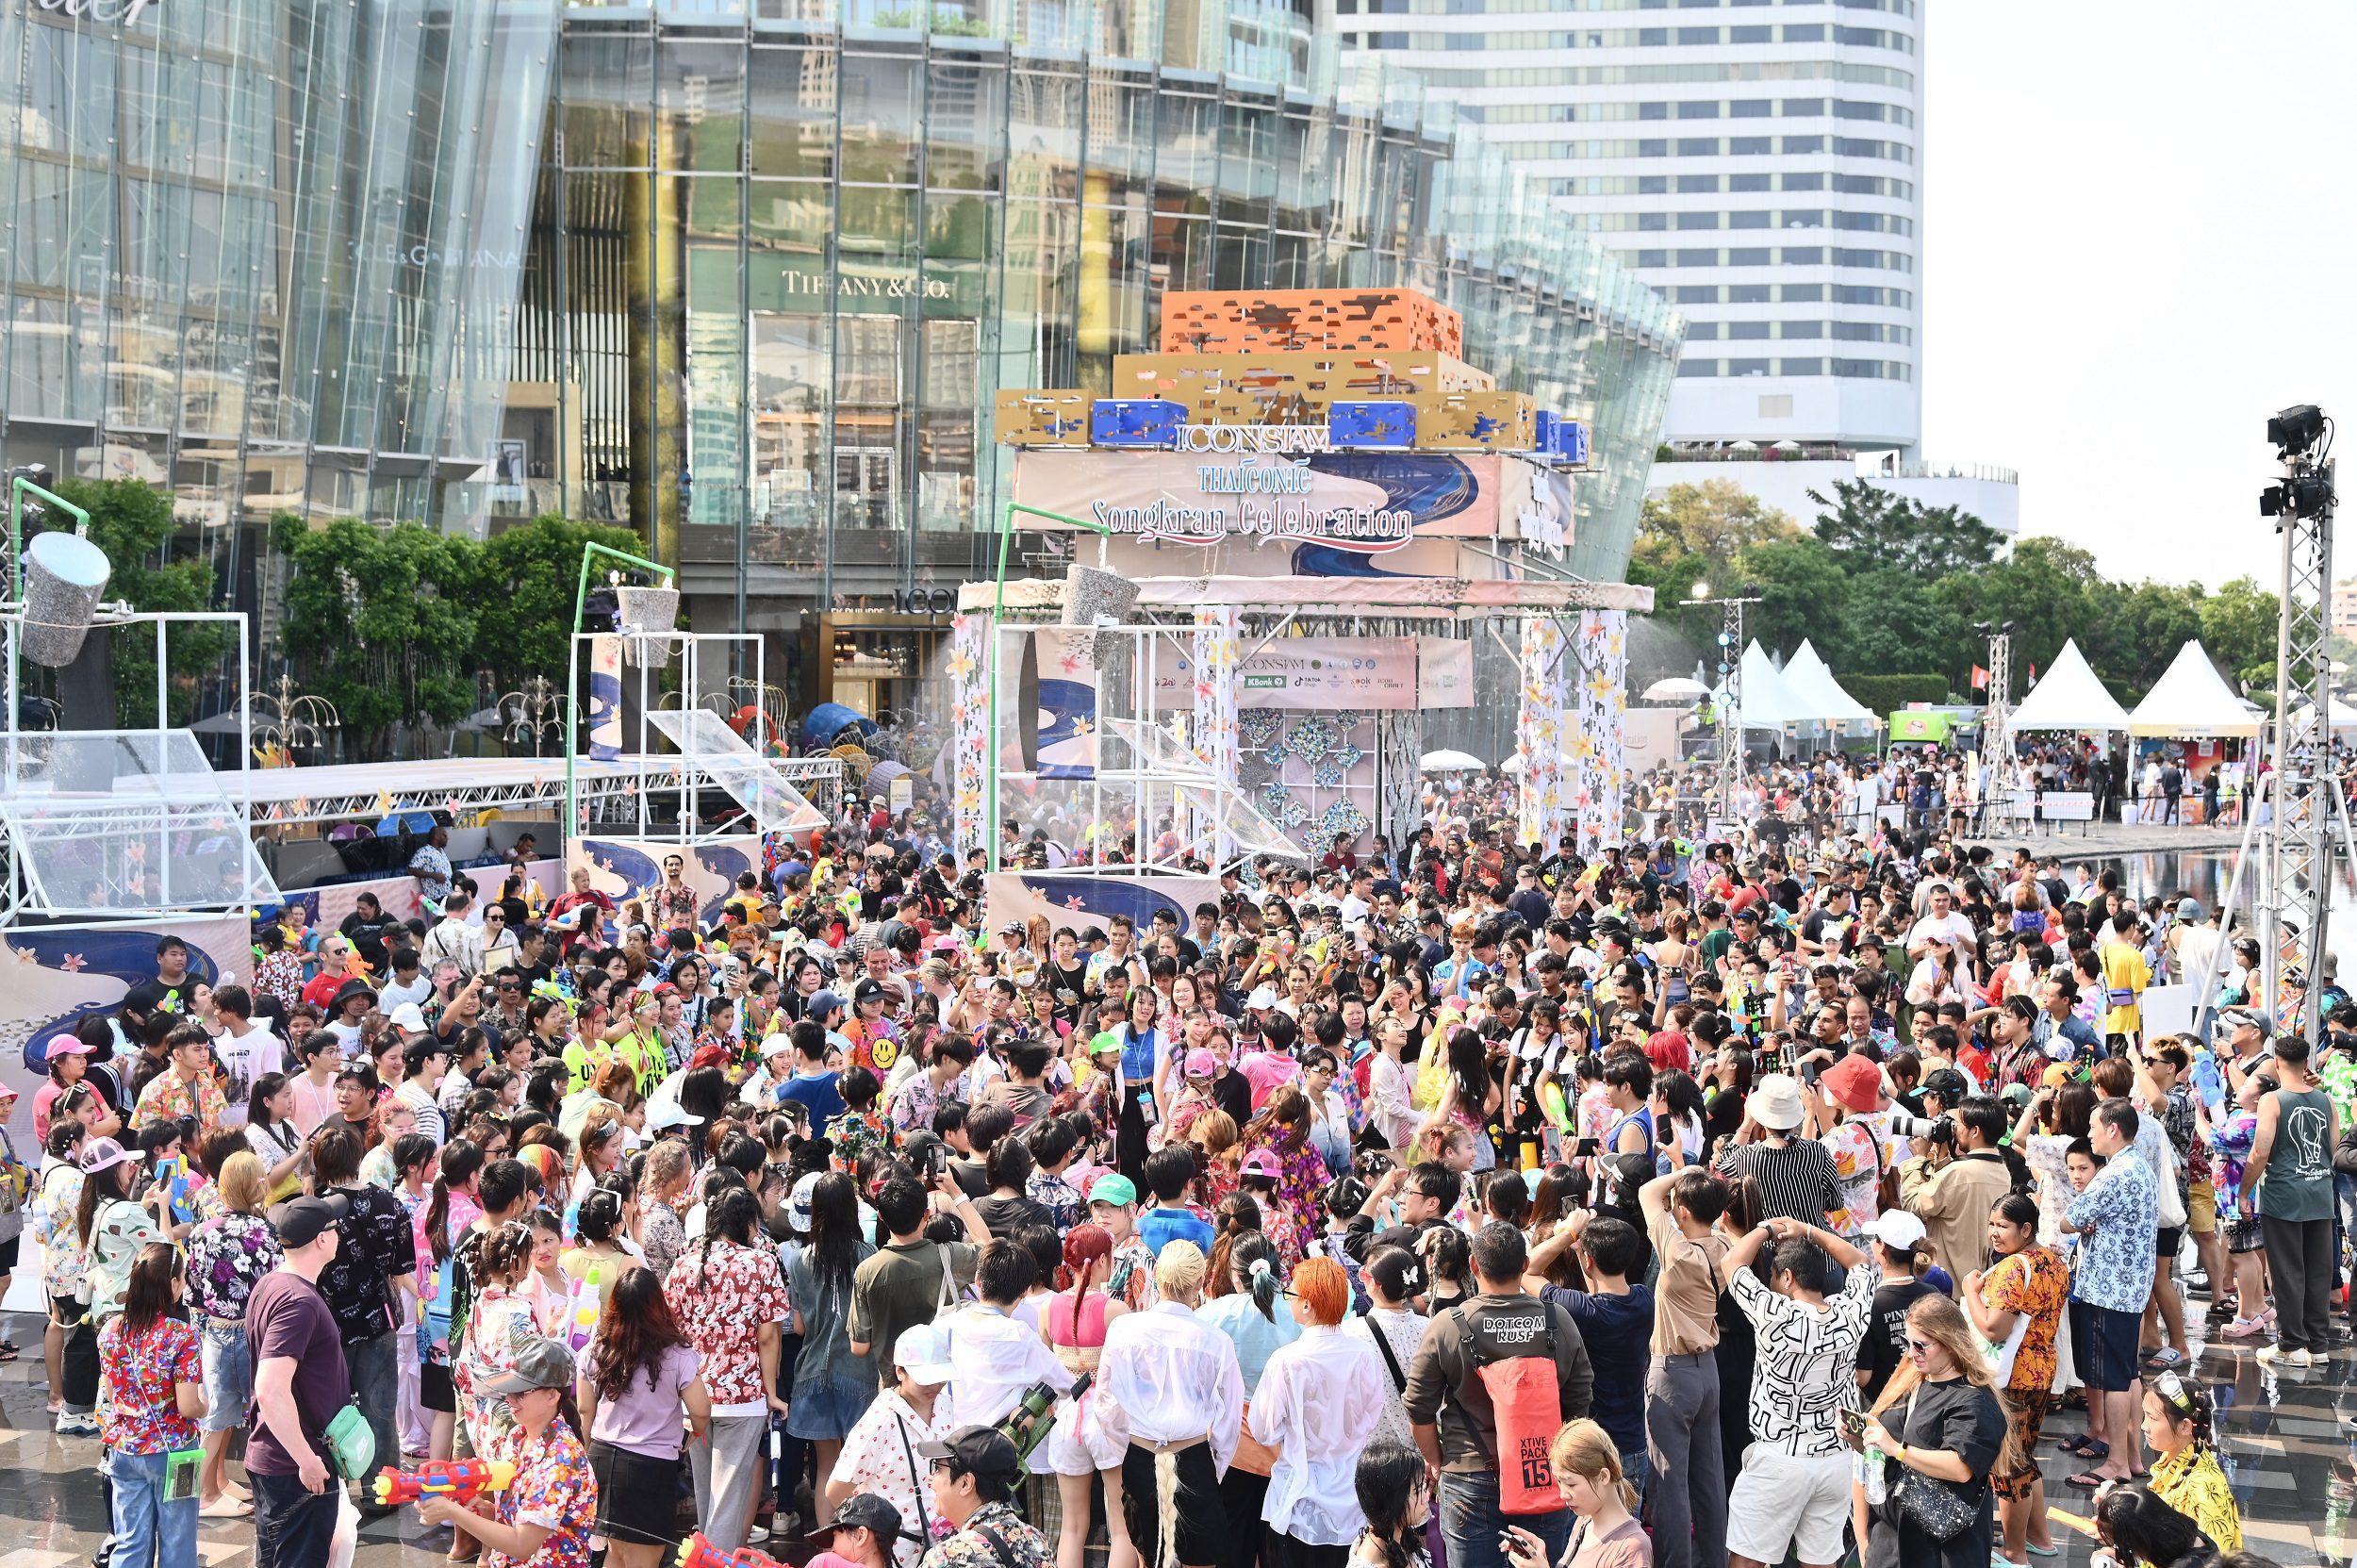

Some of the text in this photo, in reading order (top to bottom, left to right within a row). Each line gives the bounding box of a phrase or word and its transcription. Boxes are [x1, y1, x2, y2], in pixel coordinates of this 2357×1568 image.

[1175, 424, 1335, 454] ICONSIAM
[1092, 498, 1413, 552] Songkran Celebration
[1247, 675, 1273, 686] KBank
[1871, 1017, 1893, 1028] EVER
[1483, 1315, 1546, 1329] DOTCOM
[1520, 1436, 1547, 1448] XTIVE
[1521, 1446, 1549, 1460] PACK
[1524, 1460, 1551, 1487] 15
